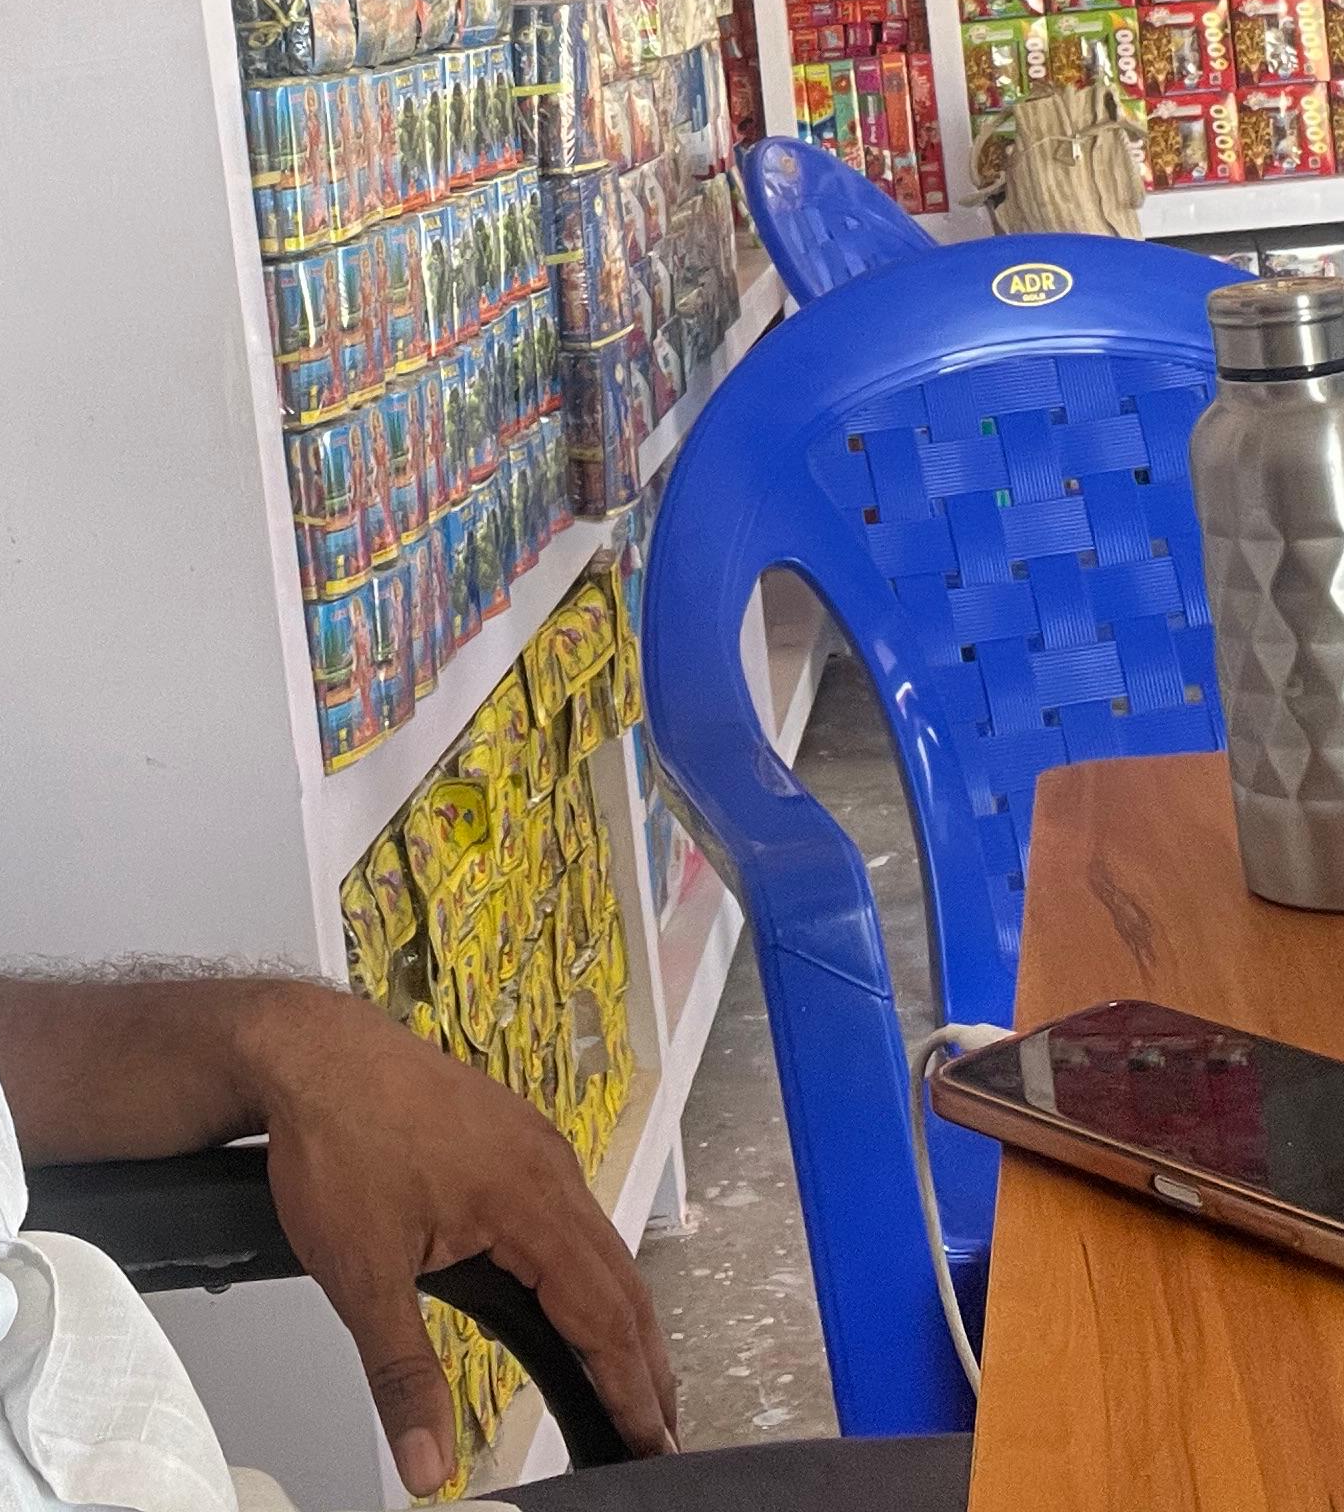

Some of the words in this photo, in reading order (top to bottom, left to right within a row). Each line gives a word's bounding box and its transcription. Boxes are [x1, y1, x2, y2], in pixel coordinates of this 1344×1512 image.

[1115, 28, 1138, 85] 6000
[1202, 11, 1229, 71] 6000
[1209, 104, 1237, 164] 6000
[1300, 95, 1329, 155] 6000
[1009, 271, 1056, 294] ADR
